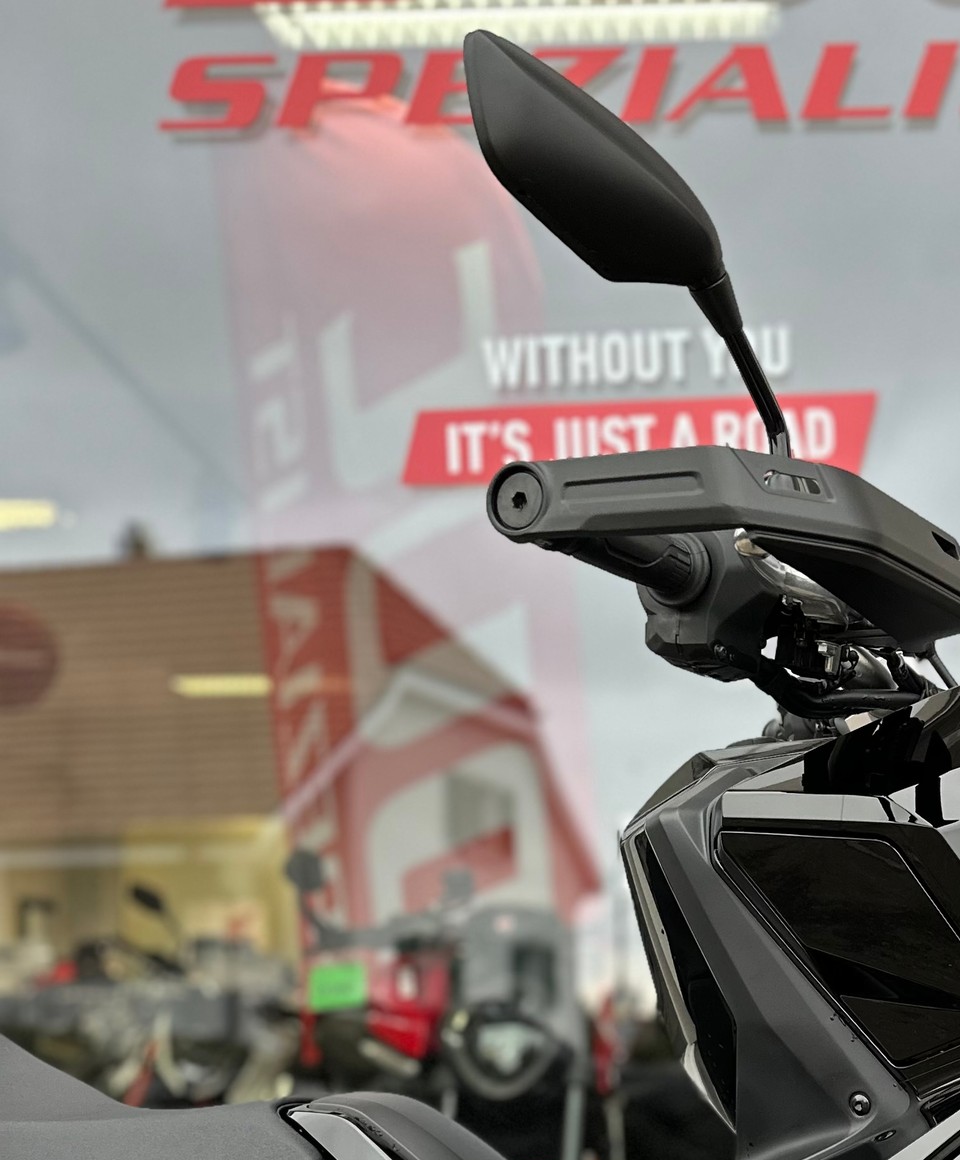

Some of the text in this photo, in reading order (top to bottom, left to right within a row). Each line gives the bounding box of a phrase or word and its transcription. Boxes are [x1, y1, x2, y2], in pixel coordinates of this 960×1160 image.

[482, 324, 794, 388] WITHOUT YU
[444, 416, 534, 476] IT'S
